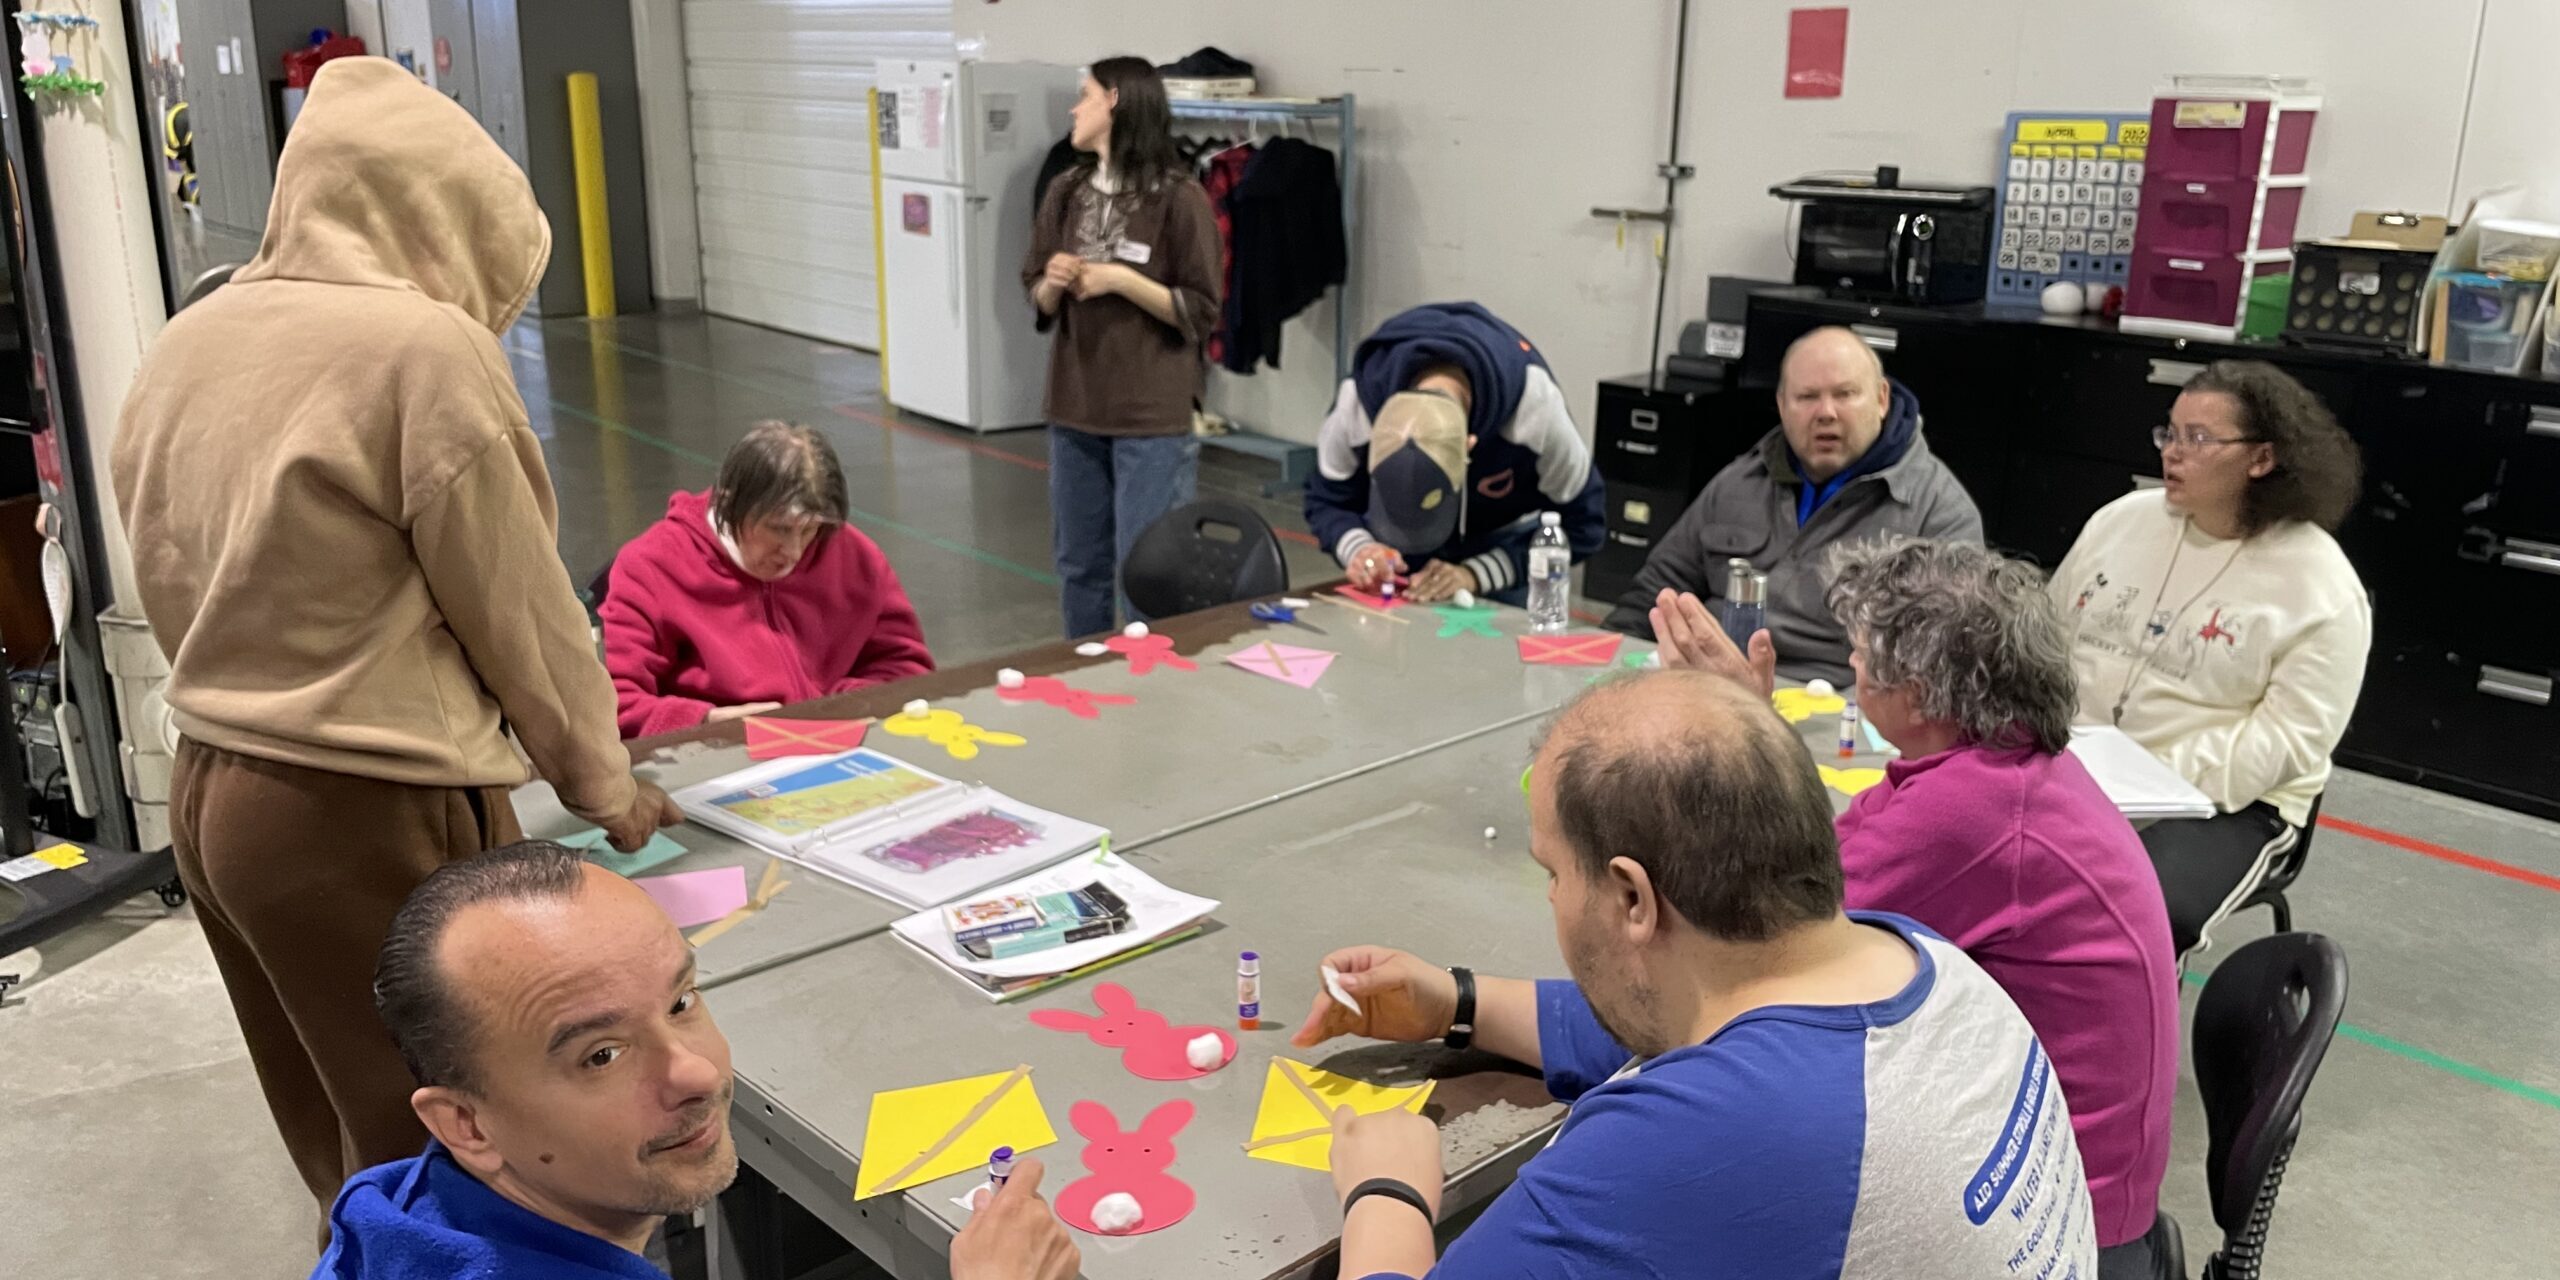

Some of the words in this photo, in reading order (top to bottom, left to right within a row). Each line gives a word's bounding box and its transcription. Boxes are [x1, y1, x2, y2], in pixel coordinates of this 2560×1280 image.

[1973, 1181, 1993, 1213] AID
[1990, 1138, 2020, 1187] SUMMER
[2011, 1167, 2040, 1223] WALTER
[2007, 1247, 2027, 1273] THE
